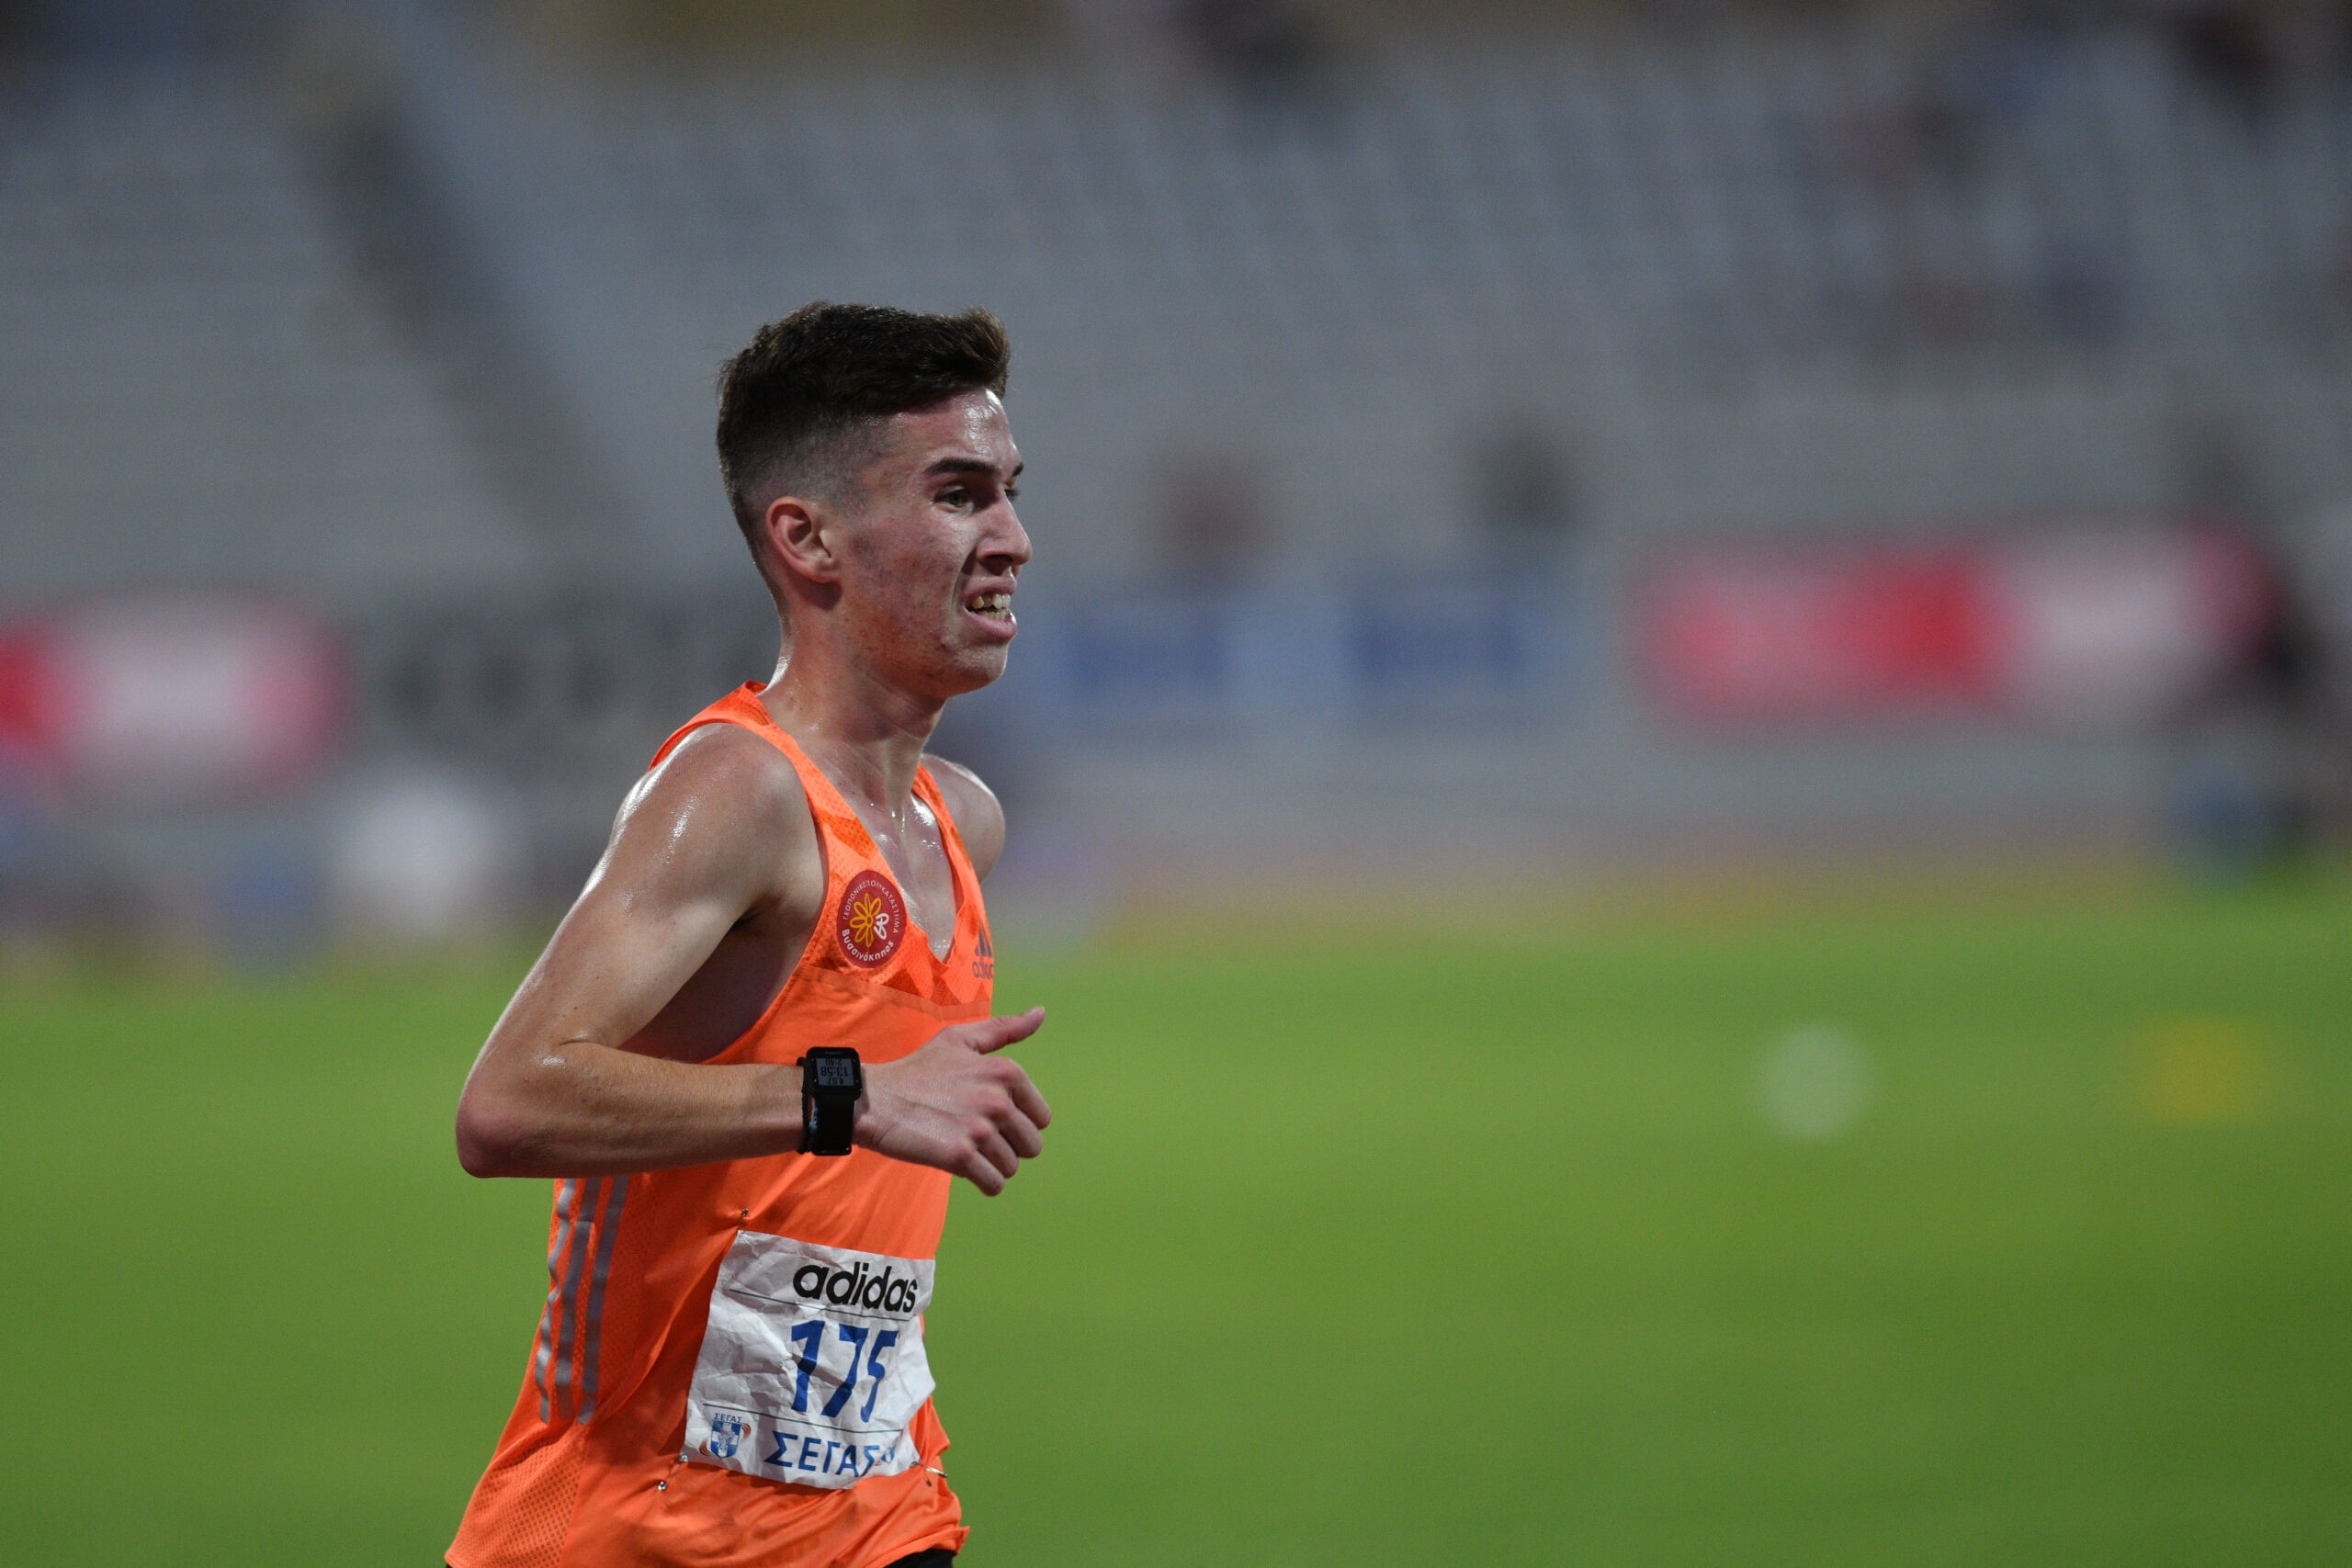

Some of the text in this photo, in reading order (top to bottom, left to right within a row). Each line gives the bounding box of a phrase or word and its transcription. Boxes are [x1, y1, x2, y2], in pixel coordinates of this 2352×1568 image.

[793, 1261, 918, 1313] adidas
[791, 1320, 899, 1423] 175
[714, 1412, 743, 1424] ΣΕΓΑΣ
[764, 1429, 880, 1478] ΣΕΓΑΣ
